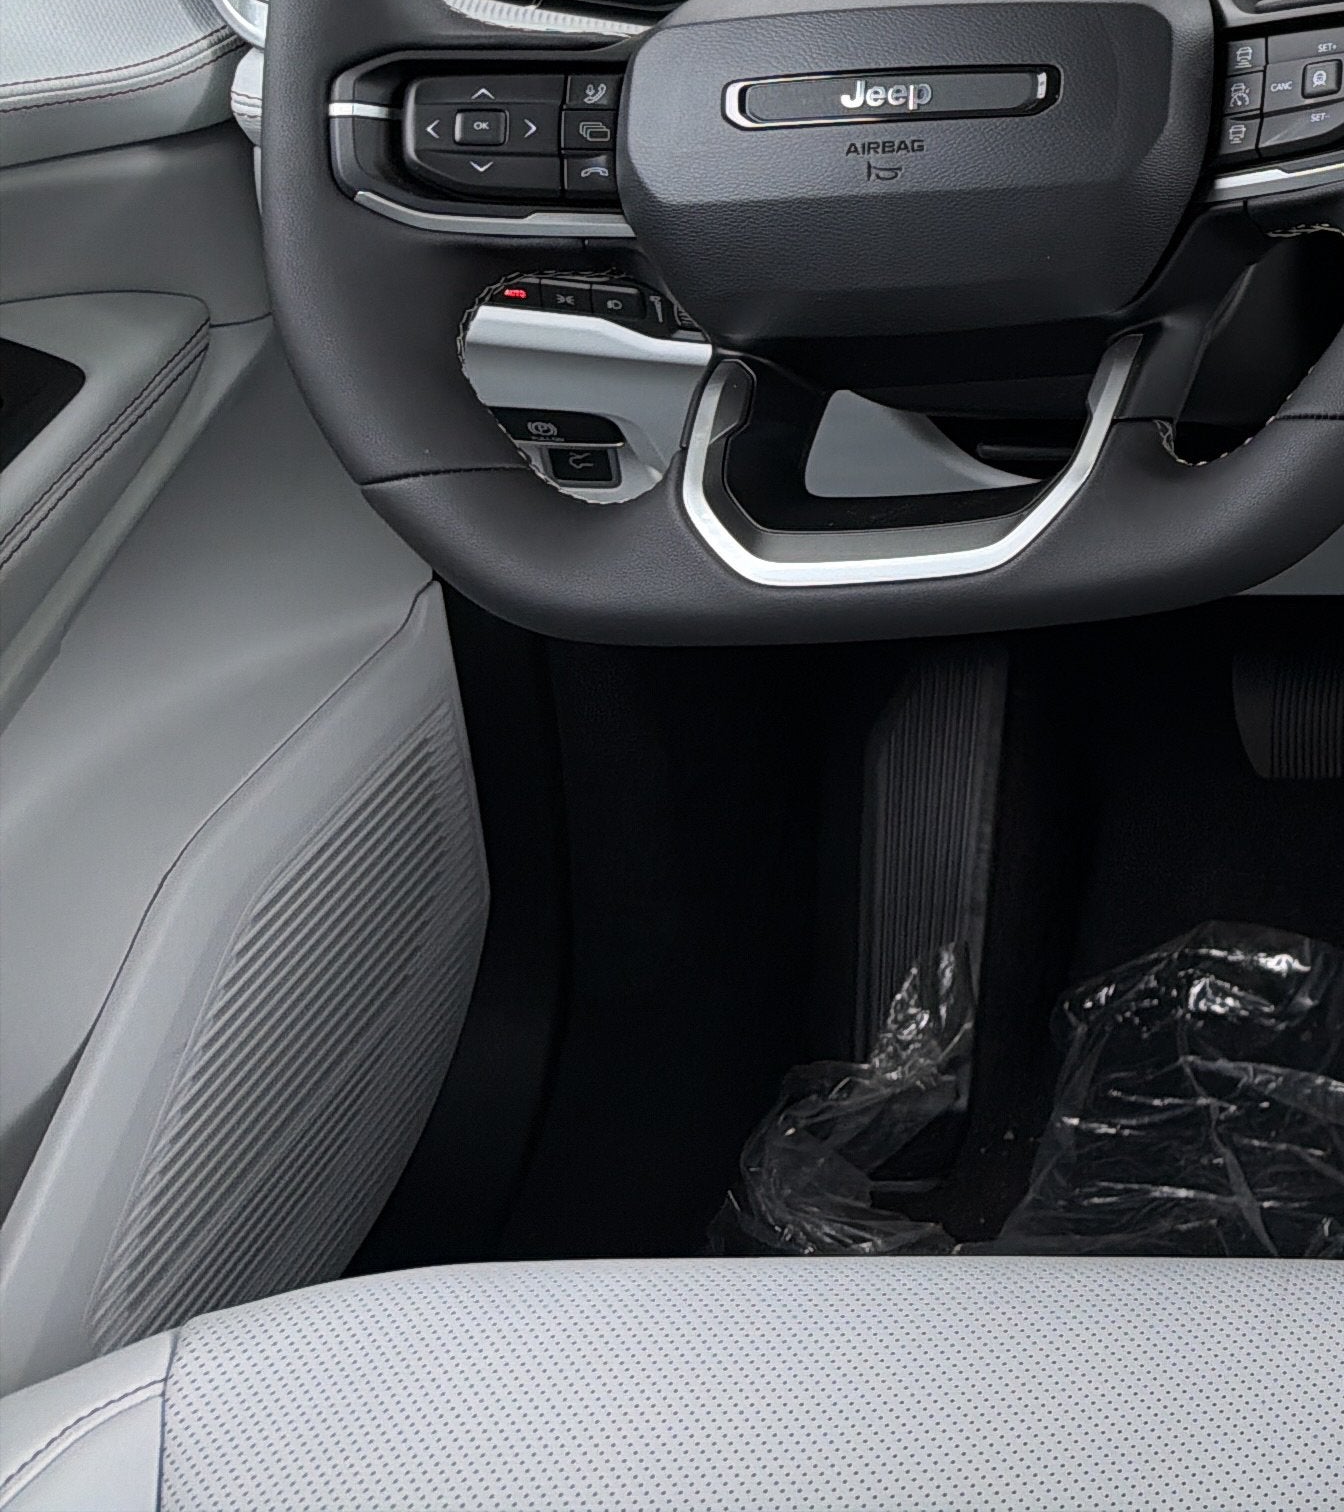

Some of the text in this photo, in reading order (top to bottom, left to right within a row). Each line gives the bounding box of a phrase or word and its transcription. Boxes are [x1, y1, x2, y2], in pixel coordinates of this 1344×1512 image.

[1270, 81, 1293, 92] CANC
[840, 79, 933, 111] Jeep
[473, 121, 490, 130] OK
[845, 138, 925, 157] AIRBAG
